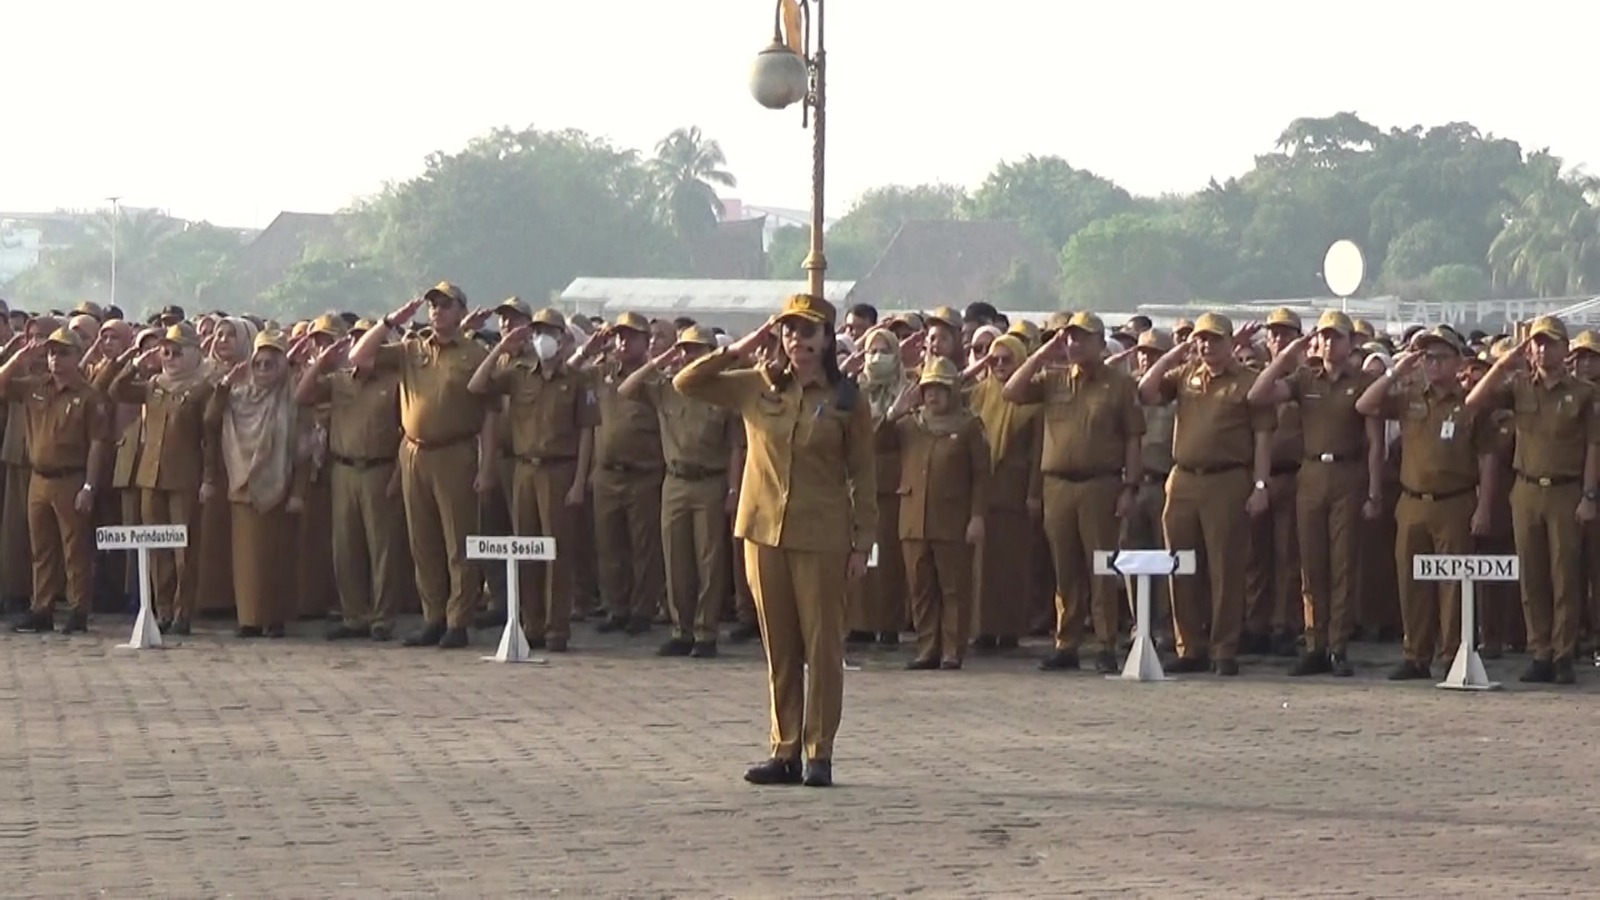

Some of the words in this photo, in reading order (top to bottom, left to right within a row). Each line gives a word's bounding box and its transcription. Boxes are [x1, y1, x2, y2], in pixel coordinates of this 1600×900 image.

[97, 529, 127, 543] Dinas
[130, 529, 185, 543] Perindustrian
[479, 540, 508, 554] Dinas
[511, 540, 545, 555] Sosial
[1420, 559, 1513, 577] BKPSDM
